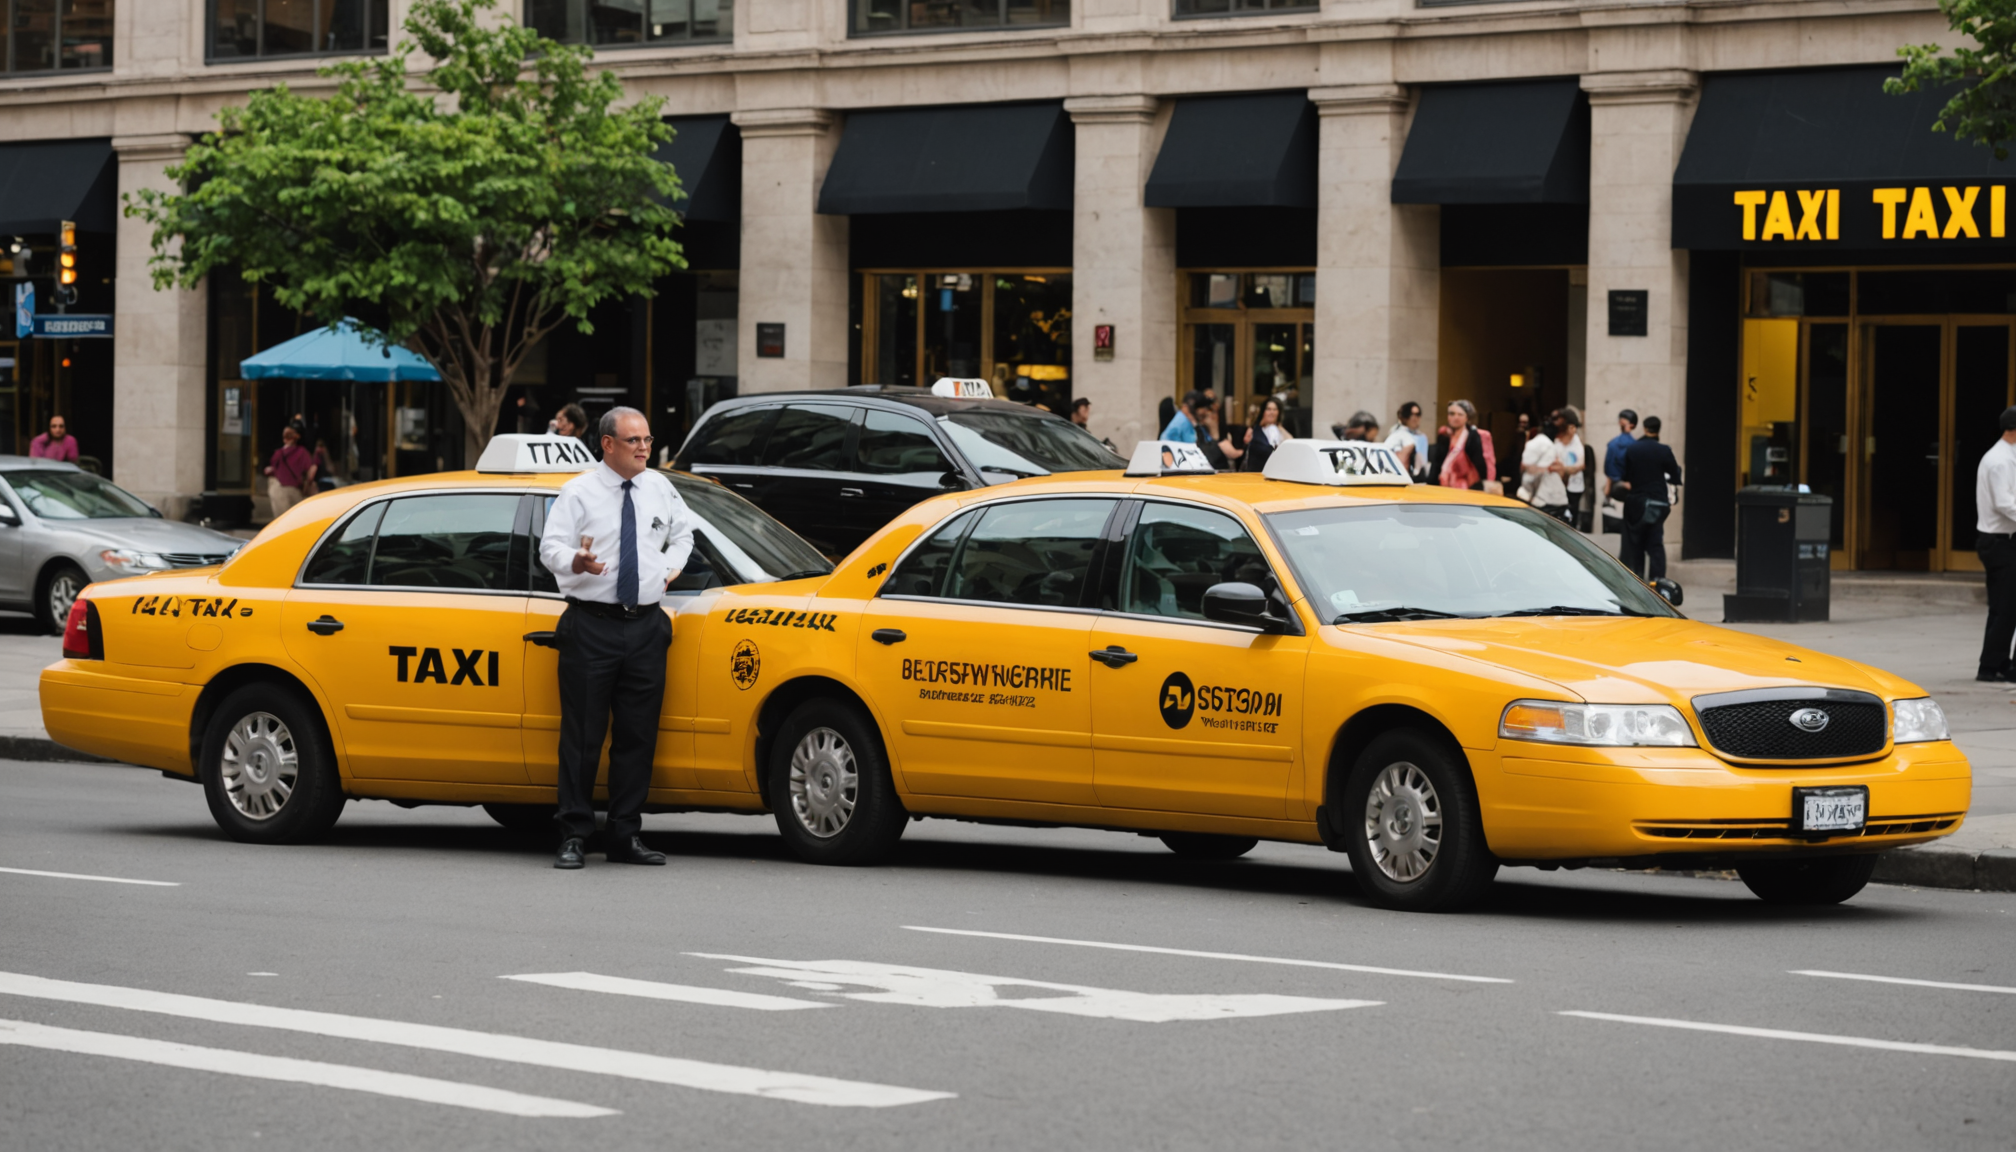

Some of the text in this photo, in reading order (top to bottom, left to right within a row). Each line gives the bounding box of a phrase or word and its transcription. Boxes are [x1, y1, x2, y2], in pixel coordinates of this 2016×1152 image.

[1733, 184, 2007, 242] TAXI TAXI
[388, 645, 499, 687] TAXI
